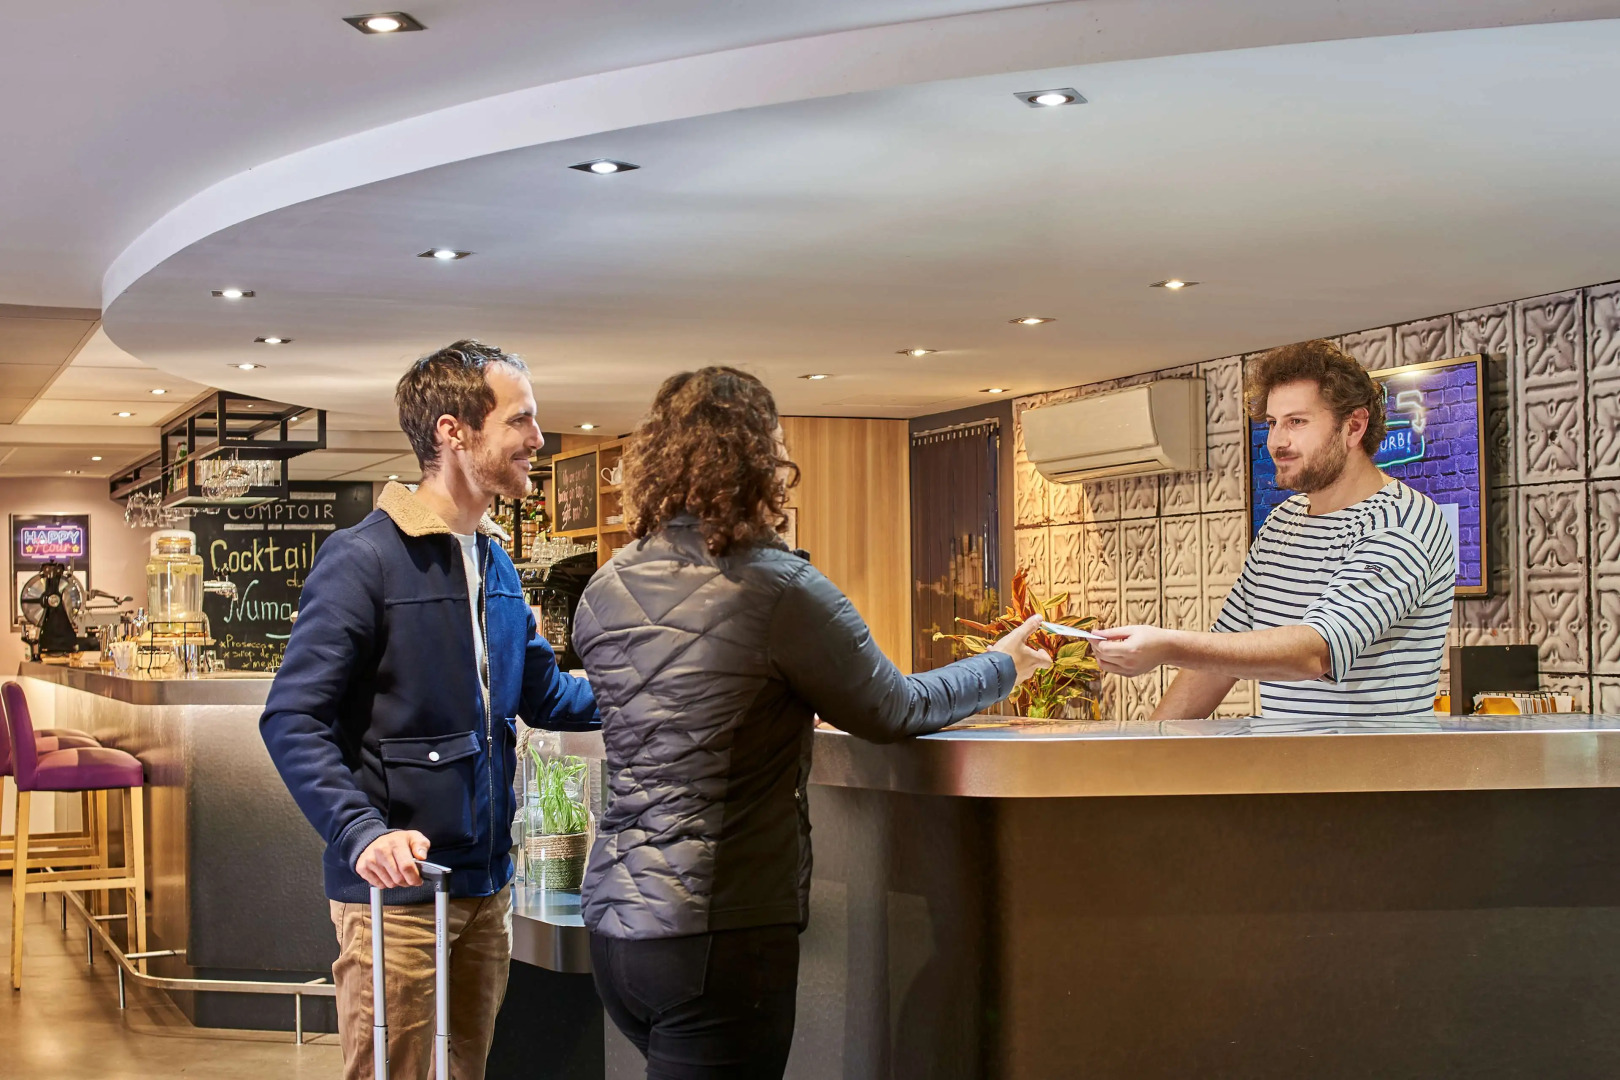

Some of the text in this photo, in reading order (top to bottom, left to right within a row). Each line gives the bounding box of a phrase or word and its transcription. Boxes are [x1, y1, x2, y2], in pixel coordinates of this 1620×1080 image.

[1380, 432, 1412, 454] URB!
[227, 504, 335, 520] COMPTOIR
[24, 530, 80, 545] HAPPY
[210, 532, 316, 573] Cocktail
[225, 633, 267, 650] Prosecco
